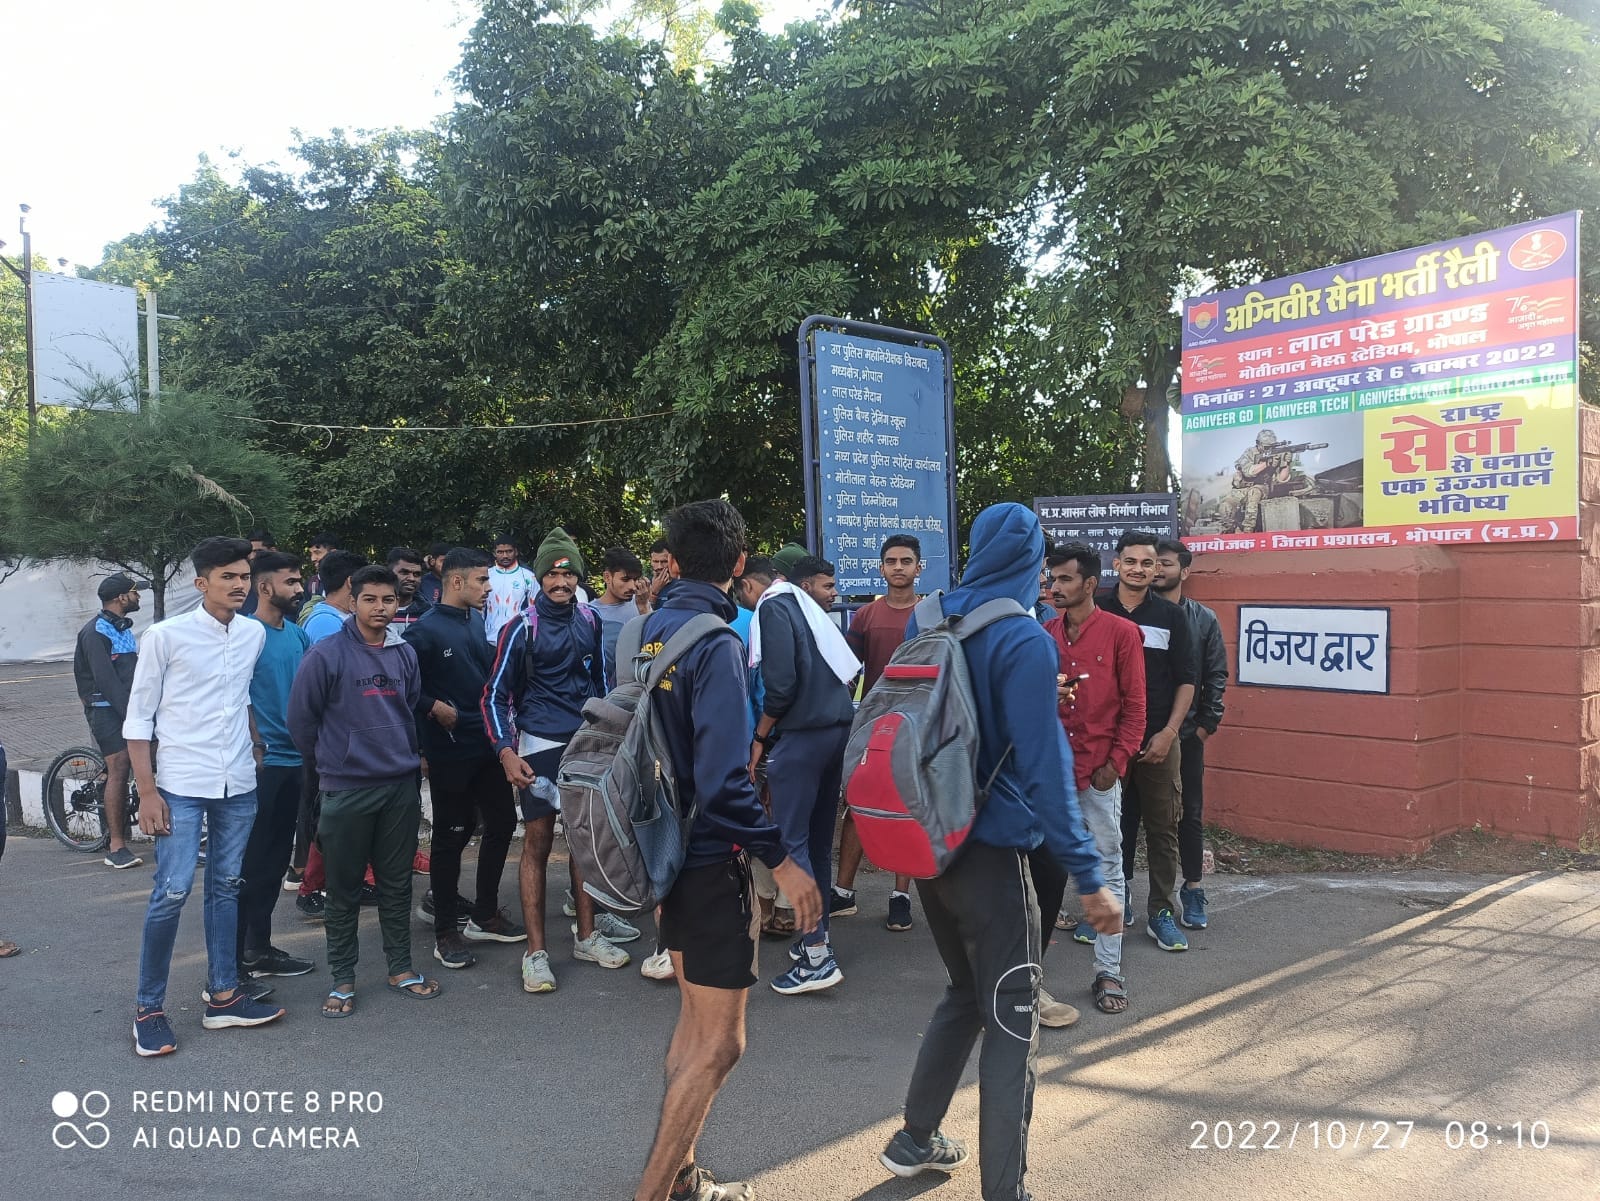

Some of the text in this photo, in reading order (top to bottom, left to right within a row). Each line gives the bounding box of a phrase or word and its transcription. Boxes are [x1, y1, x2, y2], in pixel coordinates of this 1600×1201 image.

[1223, 241, 1501, 334] अग्निवीर सेना भर्ती रैली
[1238, 347, 1273, 363] स्थान
[1288, 330, 1343, 355] लाल
[1349, 320, 1397, 343] परेड
[1404, 302, 1488, 335] ग्राउण्ड
[830, 343, 841, 356] उप
[843, 342, 863, 361] पुलिस
[864, 346, 903, 365] महानिरीक्षक
[1239, 359, 1306, 380] मोतीलाल
[1351, 341, 1420, 363] स्टेडियम,
[1427, 329, 1487, 349] भोपाल
[1193, 388, 1244, 408] दिनांक
[1262, 384, 1286, 398] 27
[1366, 367, 1385, 382] से
[1389, 365, 1403, 379] 6
[1487, 342, 1556, 366] 2022
[832, 385, 882, 404] लाल परेड मैदान
[1358, 388, 1408, 408] AGNIVEER
[832, 404, 853, 423] पुलिस
[855, 406, 870, 422] बैण्ड
[890, 416, 907, 431] स्कूल
[1265, 396, 1349, 419] AGNIVEER TECH
[1440, 402, 1503, 422] राष्ट्र
[1186, 409, 1254, 431] AGNIVEER GD
[834, 425, 900, 446] पुलिस शहीद स्मारक
[1380, 414, 1523, 474] सेवा
[834, 450, 850, 462] मध्य
[852, 449, 868, 464] प्रदेश
[870, 450, 890, 469] पुलिस
[914, 457, 941, 472] कार्यालय
[1451, 447, 1555, 473] से बनाएं
[834, 468, 866, 485] मोतीलाल
[890, 474, 915, 490] स्टेडियम
[1380, 468, 1554, 496] एक उज्जवल
[836, 490, 856, 509] पुलिस
[1088, 504, 1107, 518] लोक
[1108, 502, 1139, 517] निर्माण
[1140, 501, 1170, 516] विभाग
[1418, 494, 1509, 515] भविष्य
[863, 512, 879, 531] पुलिस
[837, 533, 858, 552] पुलिस
[1067, 529, 1080, 538] नाम
[1088, 528, 1104, 538] लाल
[1187, 537, 1256, 552] आयोजक
[1271, 534, 1319, 548] जिला
[1322, 532, 1397, 547] प्रशासन,
[1405, 527, 1472, 542] भोपाल
[1481, 521, 1560, 543] (म.प्र.)
[838, 554, 858, 573] पुलिस
[839, 578, 871, 591] मुख्यालय
[1245, 619, 1379, 672] विजय द्वार
